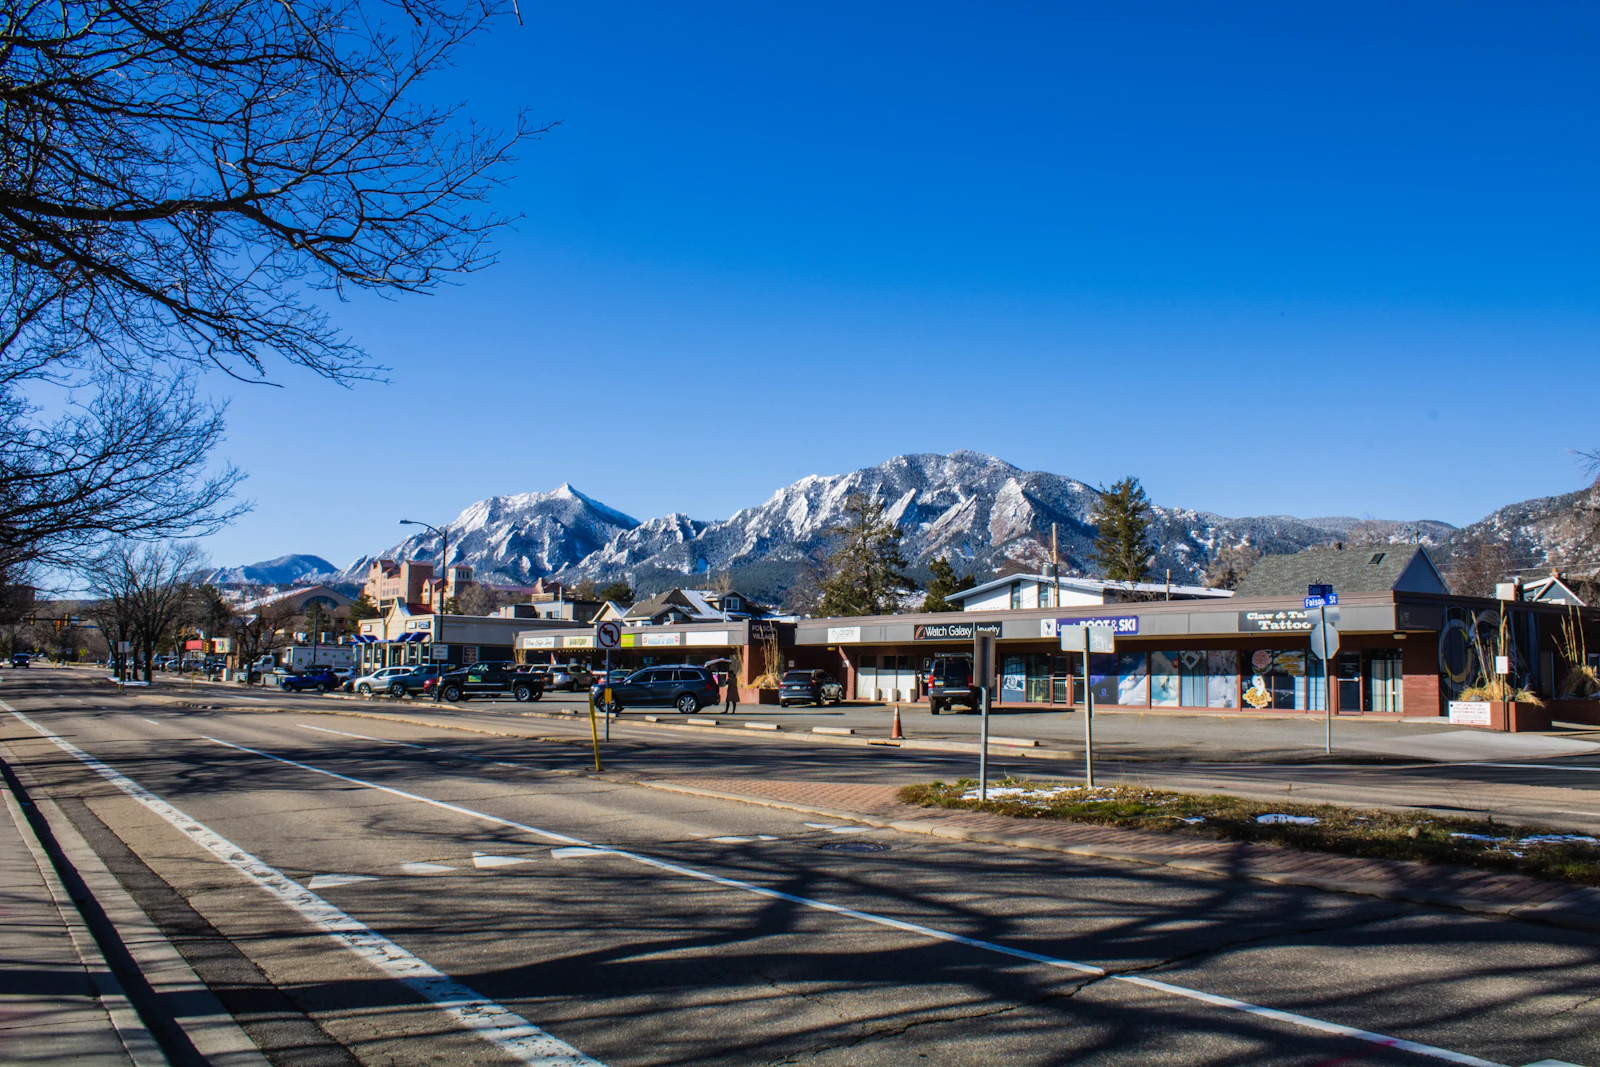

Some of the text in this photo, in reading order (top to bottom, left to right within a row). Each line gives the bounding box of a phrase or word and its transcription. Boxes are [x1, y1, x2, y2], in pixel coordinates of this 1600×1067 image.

[1329, 596, 1337, 604] St
[1246, 612, 1274, 620] Claw
[1275, 611, 1287, 619] &
[1111, 619, 1118, 632] &
[1118, 618, 1136, 632] SKI
[1258, 620, 1312, 630] Tattoo
[925, 626, 947, 637] Watch
[949, 625, 973, 638] Galaxy
